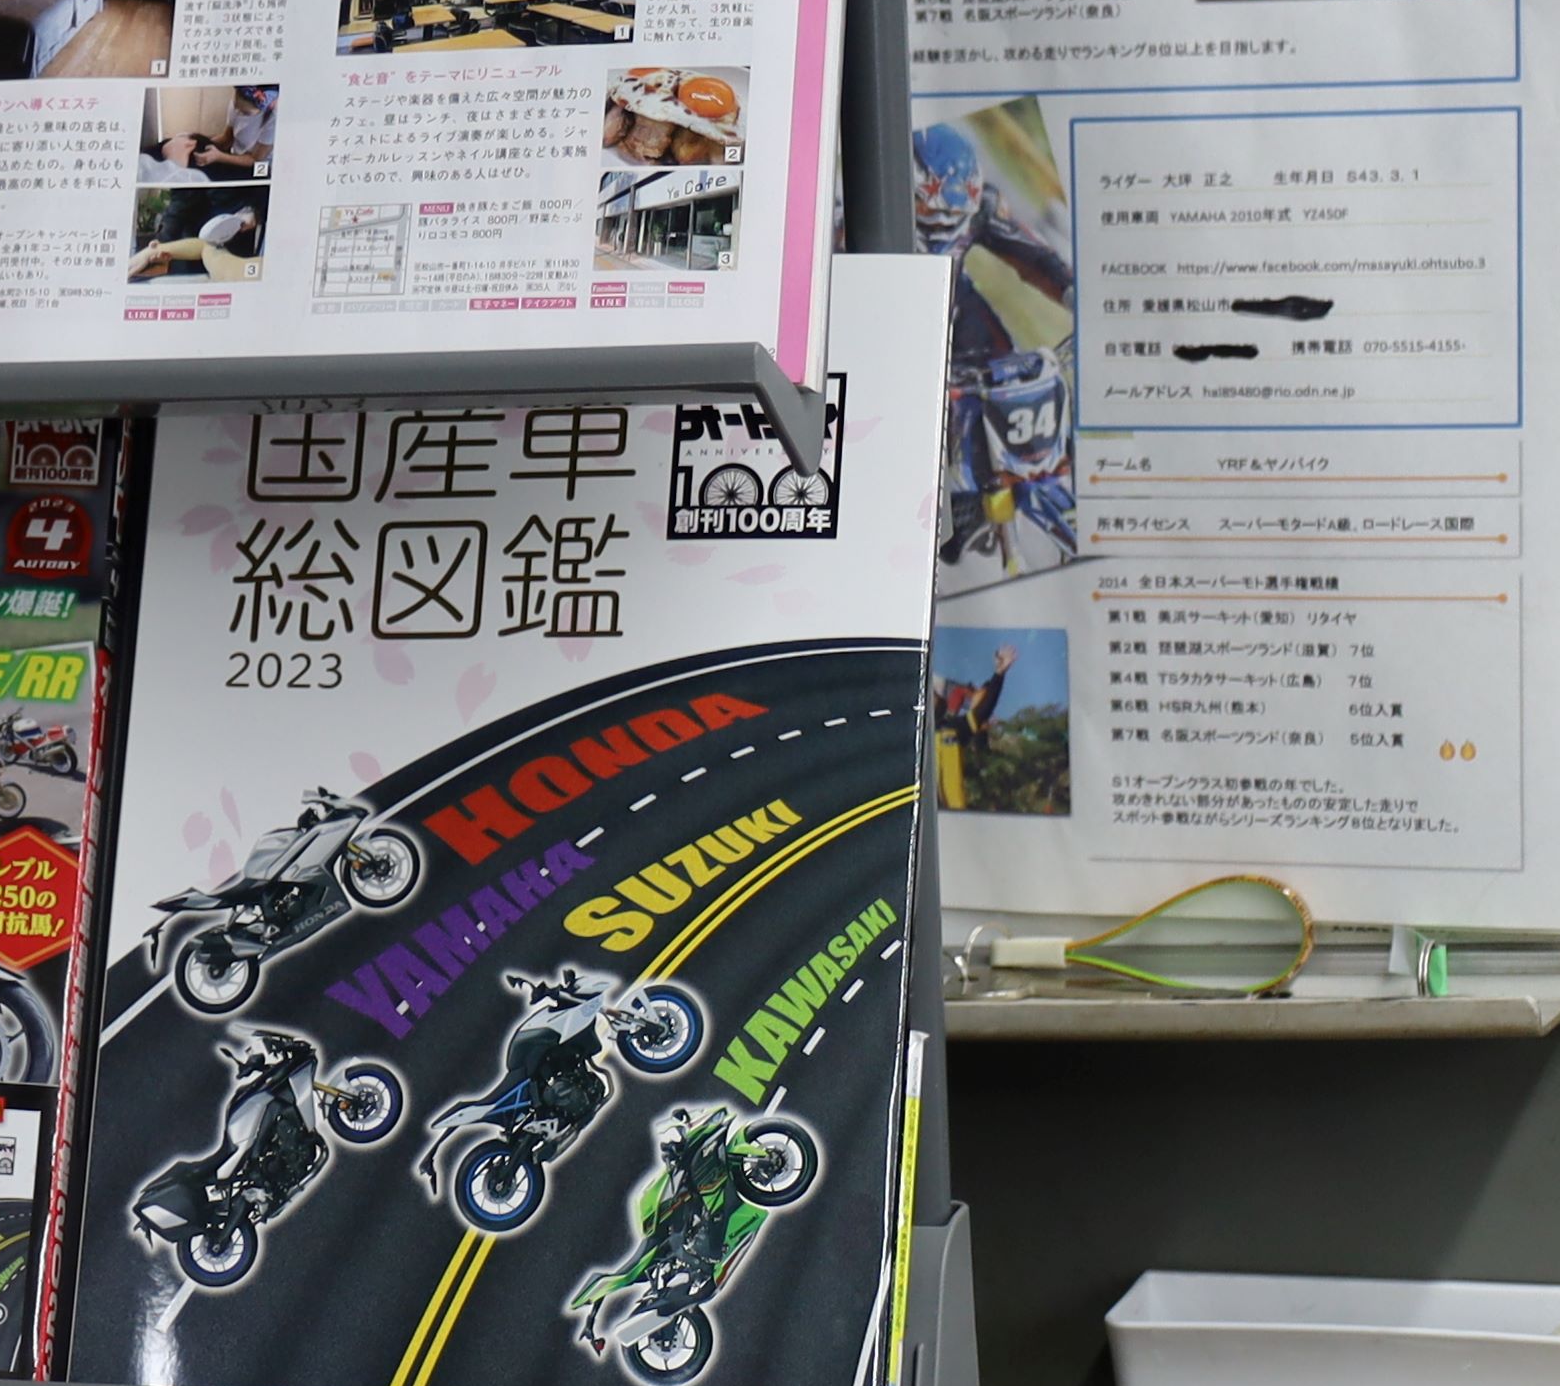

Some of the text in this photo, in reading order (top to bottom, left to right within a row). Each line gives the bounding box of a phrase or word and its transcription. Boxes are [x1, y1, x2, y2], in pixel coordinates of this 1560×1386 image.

[593, 297, 623, 309] LINE
[1005, 408, 1054, 445] 34
[246, 406, 636, 504] 国産車
[24, 518, 73, 551] 4
[674, 507, 832, 535] 創刊100周年
[13, 558, 80, 570] AUTOBY
[229, 513, 631, 643] 総図鑑
[1097, 575, 1129, 590] 2014
[1108, 611, 1148, 625] 第1戦
[224, 652, 345, 690] 2023
[423, 691, 769, 866] HONDA
[562, 798, 804, 953] SUZUKI
[325, 839, 599, 1040] YAMAHA
[713, 897, 898, 1106] KAWASAKI
